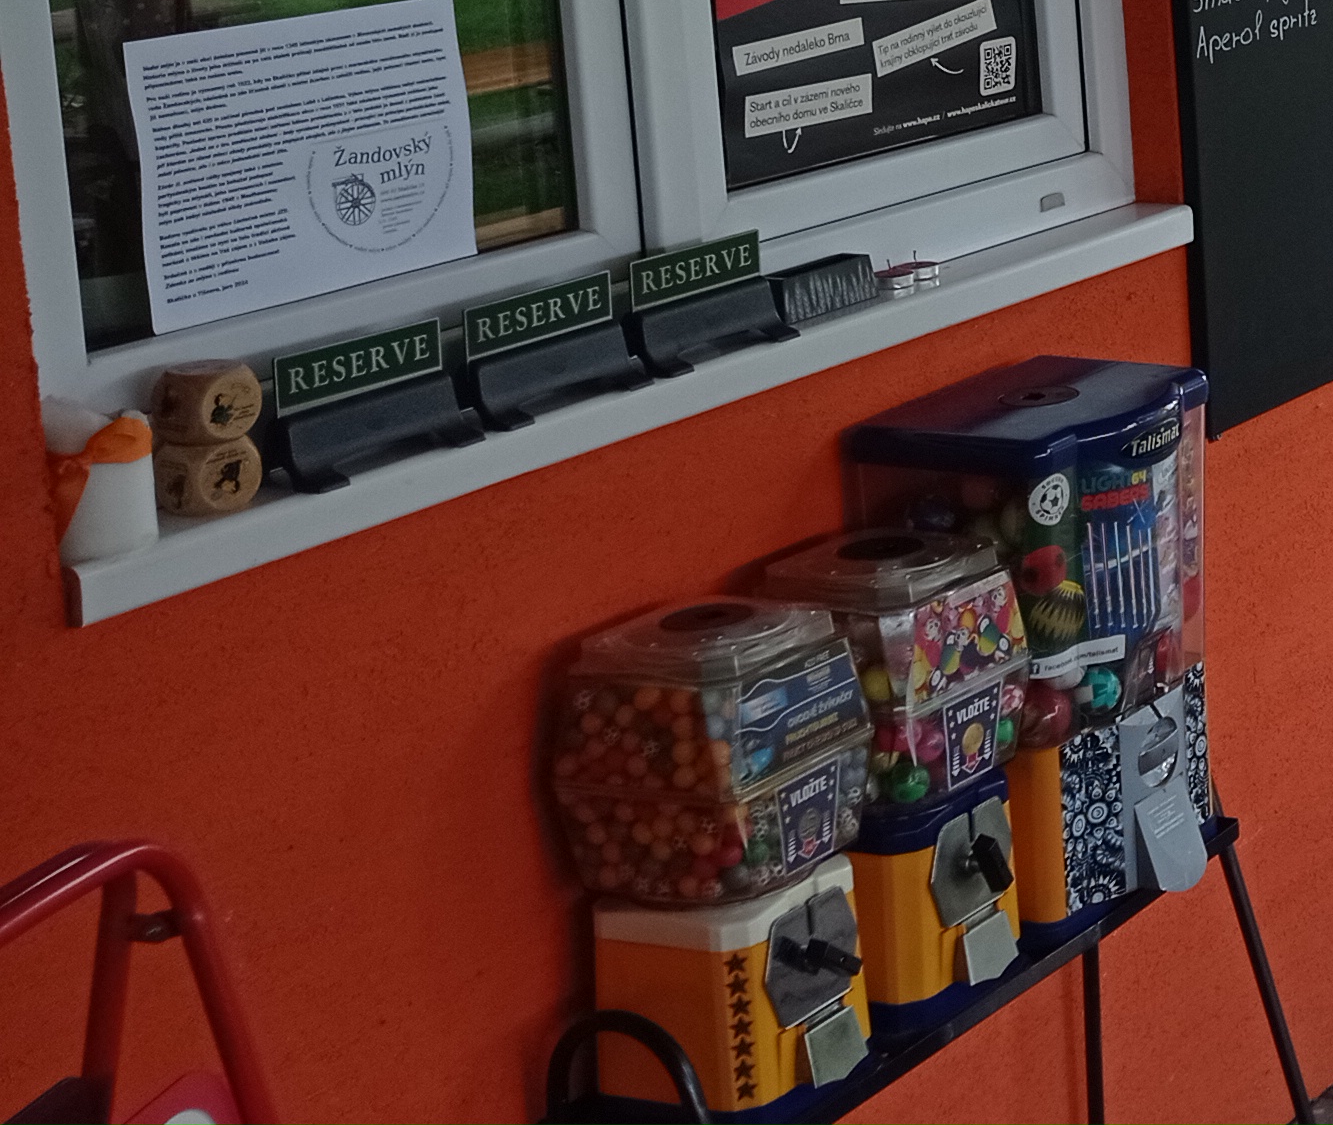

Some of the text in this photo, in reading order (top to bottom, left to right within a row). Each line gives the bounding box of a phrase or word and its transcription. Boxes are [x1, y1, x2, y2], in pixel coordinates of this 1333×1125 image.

[744, 32, 850, 66] Závody nedaleko Brna
[1196, 12, 1262, 64] Aperol
[333, 131, 432, 167] Žandovský
[379, 158, 425, 186] mlýn
[640, 241, 753, 295] RESERVE
[476, 283, 603, 344] RESERVE
[287, 332, 431, 395] RESERVE
[956, 695, 990, 725] VLOŽTE
[790, 775, 827, 808] VLOŽTE
